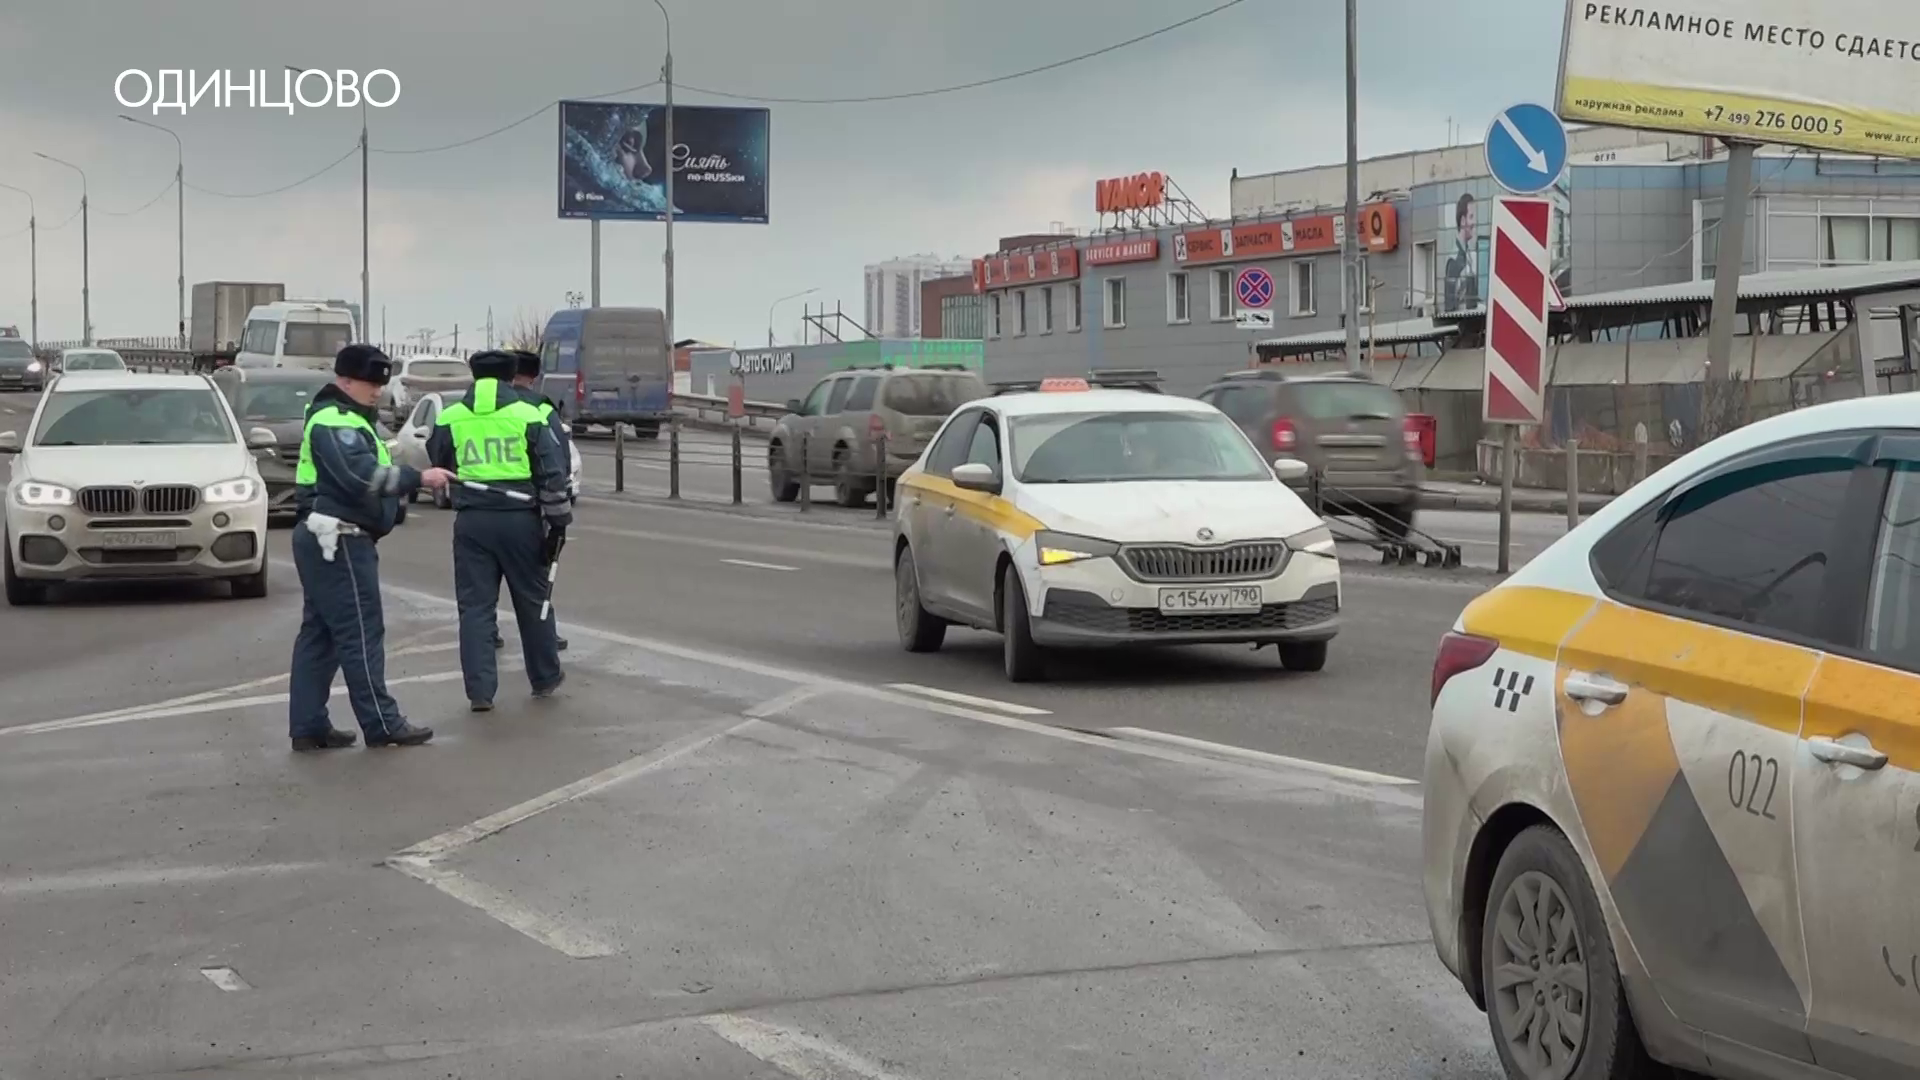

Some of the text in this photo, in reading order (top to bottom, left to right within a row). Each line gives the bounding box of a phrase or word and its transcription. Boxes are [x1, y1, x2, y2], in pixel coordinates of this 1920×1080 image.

[1585, 3, 1734, 38] РЕКЛАМНОЕ
[1744, 22, 1825, 49] МЕСТО
[1575, 99, 1684, 117] наружная реклама
[1704, 105, 1843, 136] +7 499 276 000 5
[1096, 171, 1164, 212] IVANOR
[1235, 231, 1273, 249] ЗАПЧАСТИ
[1296, 227, 1323, 241] МАСЛА
[1728, 749, 1779, 820] 022
